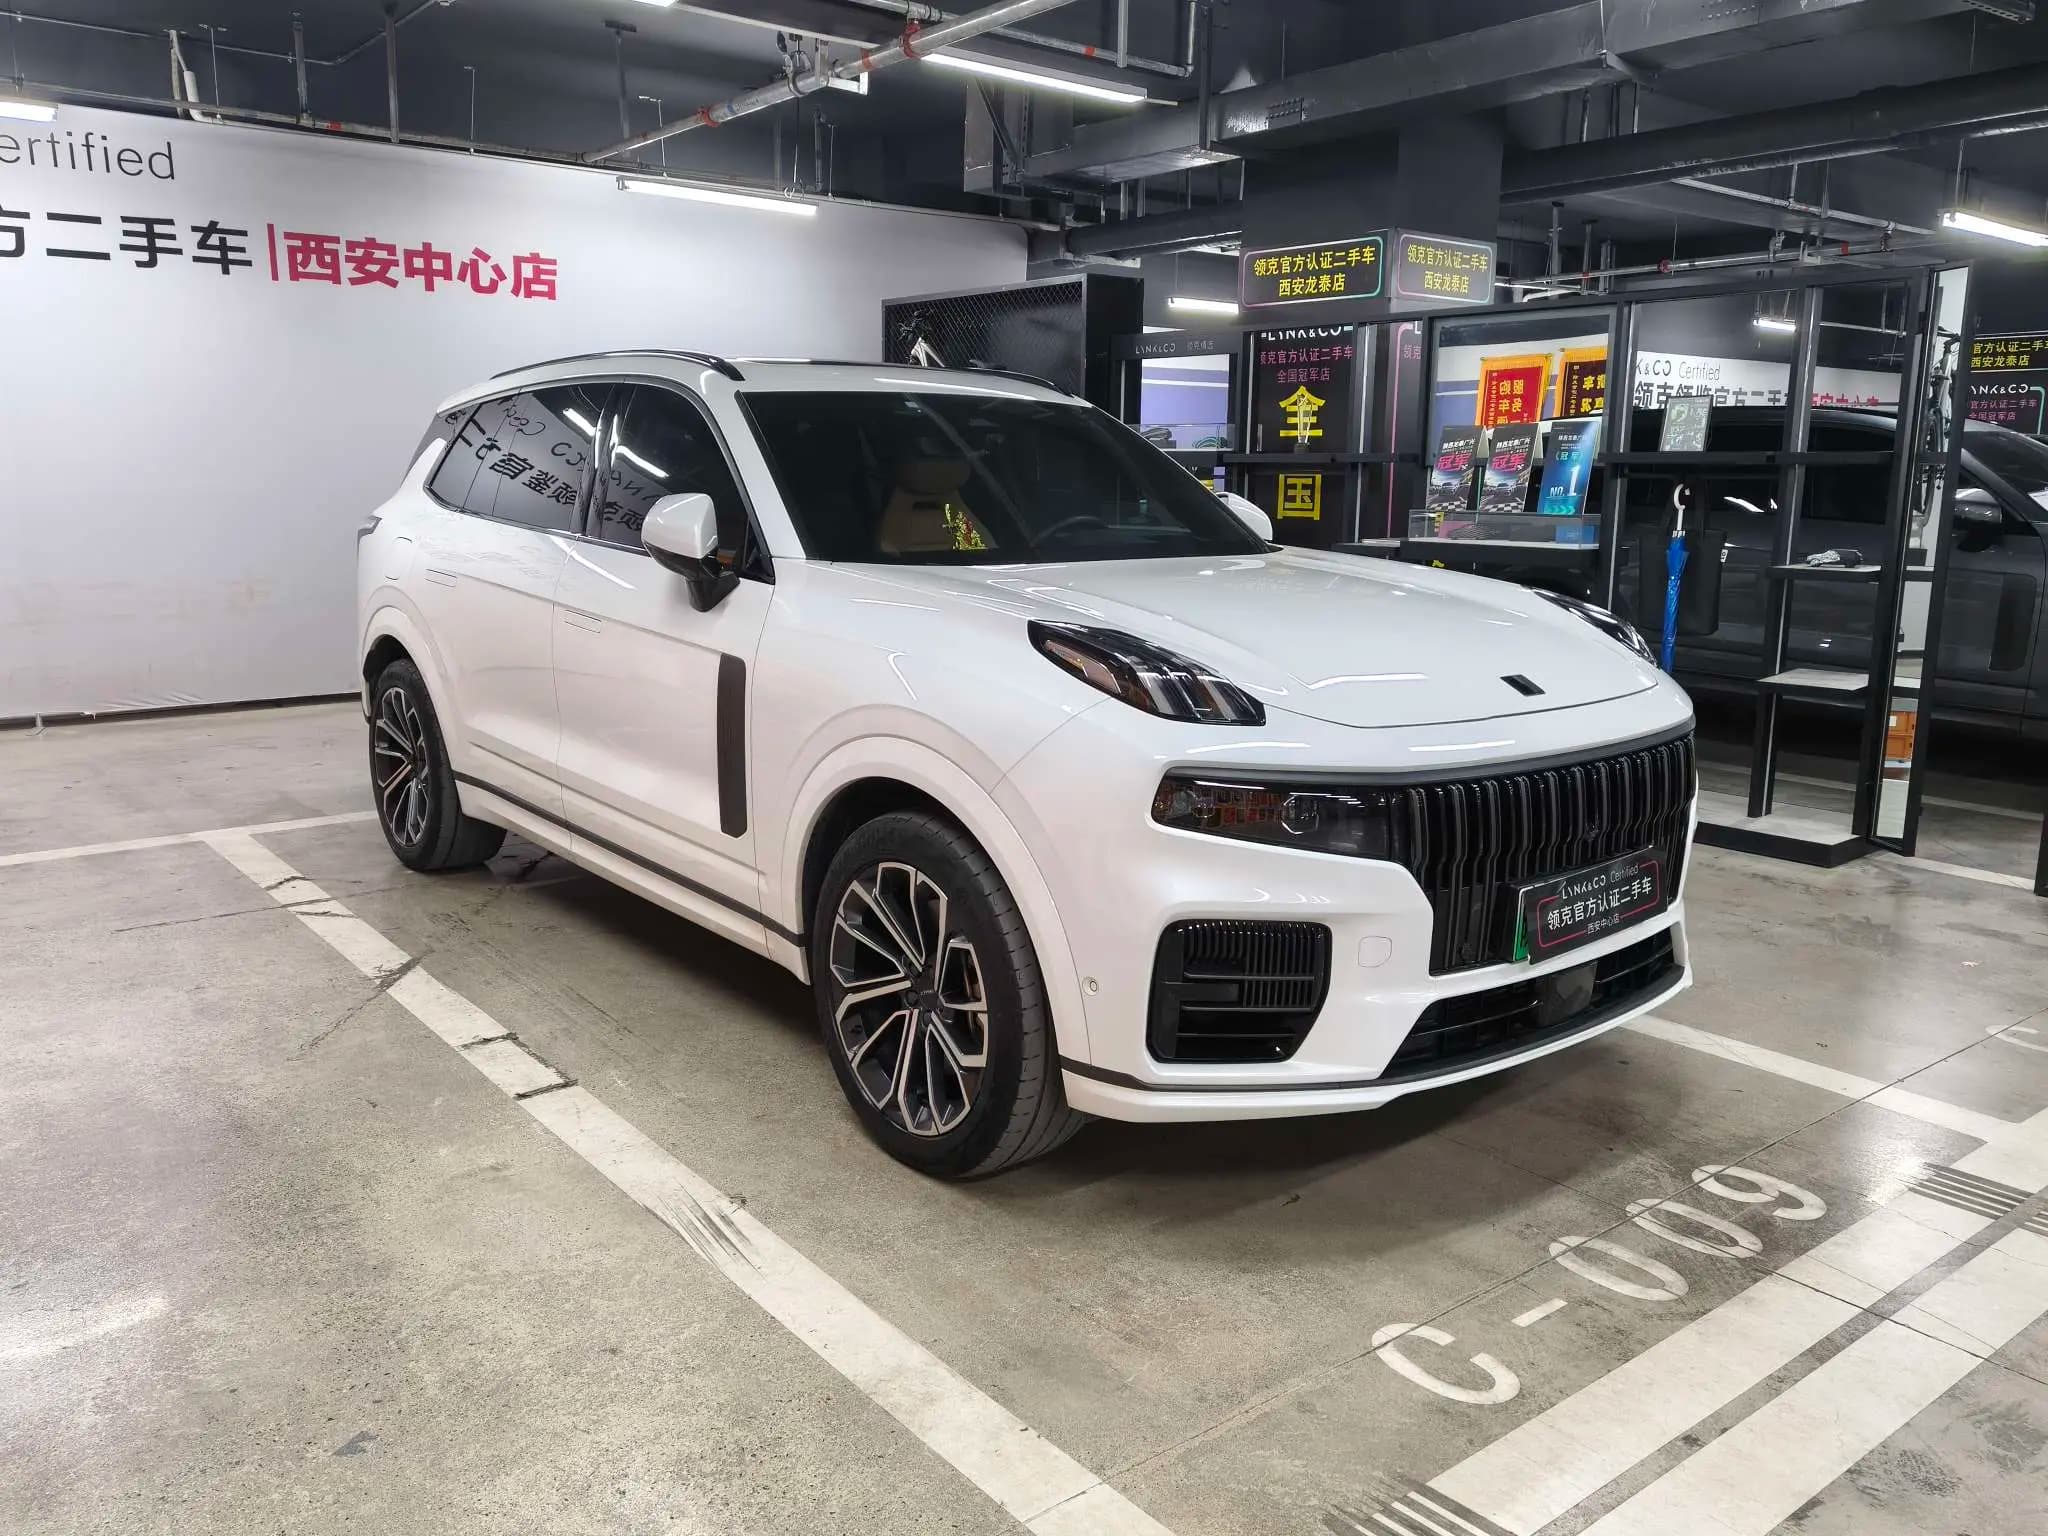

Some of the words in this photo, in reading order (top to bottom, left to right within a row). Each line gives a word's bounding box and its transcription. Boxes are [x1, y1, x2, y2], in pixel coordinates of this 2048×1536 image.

[284, 230, 558, 301] 西安中心店
[1254, 245, 1376, 277] 领克官方认证二手车
[1407, 243, 1489, 273] 领克官方认证二手车
[1278, 272, 1346, 297] 西安龙泰店
[1424, 270, 1469, 294] 西安龙泰店
[1277, 367, 1331, 383] 全国冠军店
[1970, 354, 2030, 368] 西安龙泰店
[1561, 875, 1607, 900] LYNK&CO
[1609, 863, 1640, 883] Certified
[1547, 876, 1653, 931] 领克官方认证二手车
